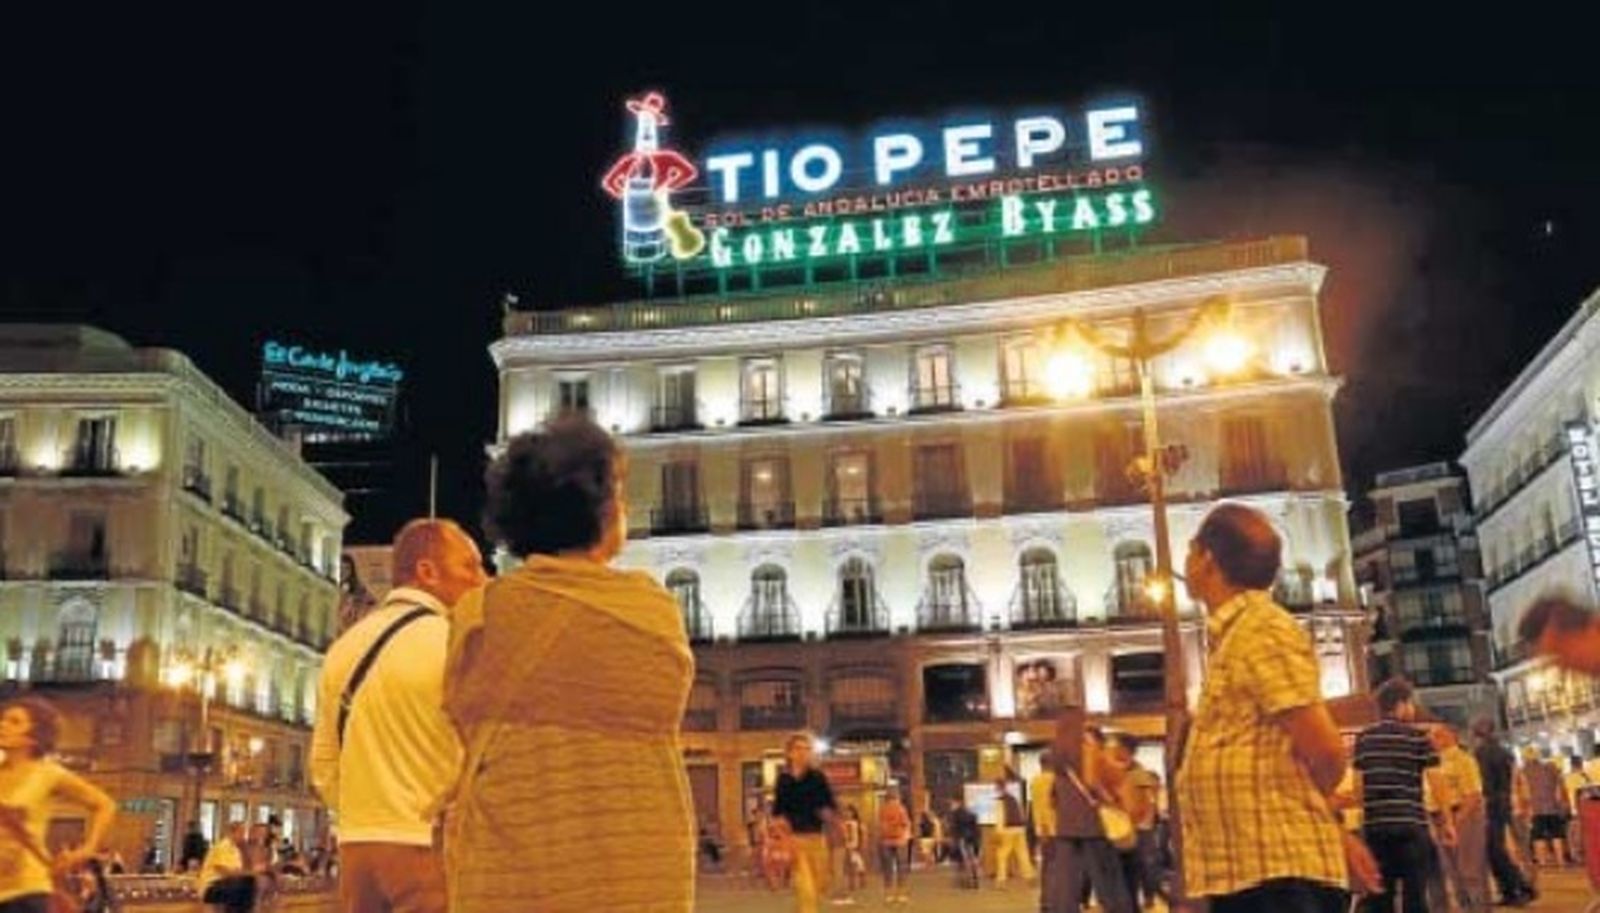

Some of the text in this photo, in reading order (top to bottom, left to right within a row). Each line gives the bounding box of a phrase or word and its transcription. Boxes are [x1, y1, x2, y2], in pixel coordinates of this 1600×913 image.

[706, 106, 1143, 202] TIO PEPE
[710, 189, 1154, 268] GONZALEZ BYASS
